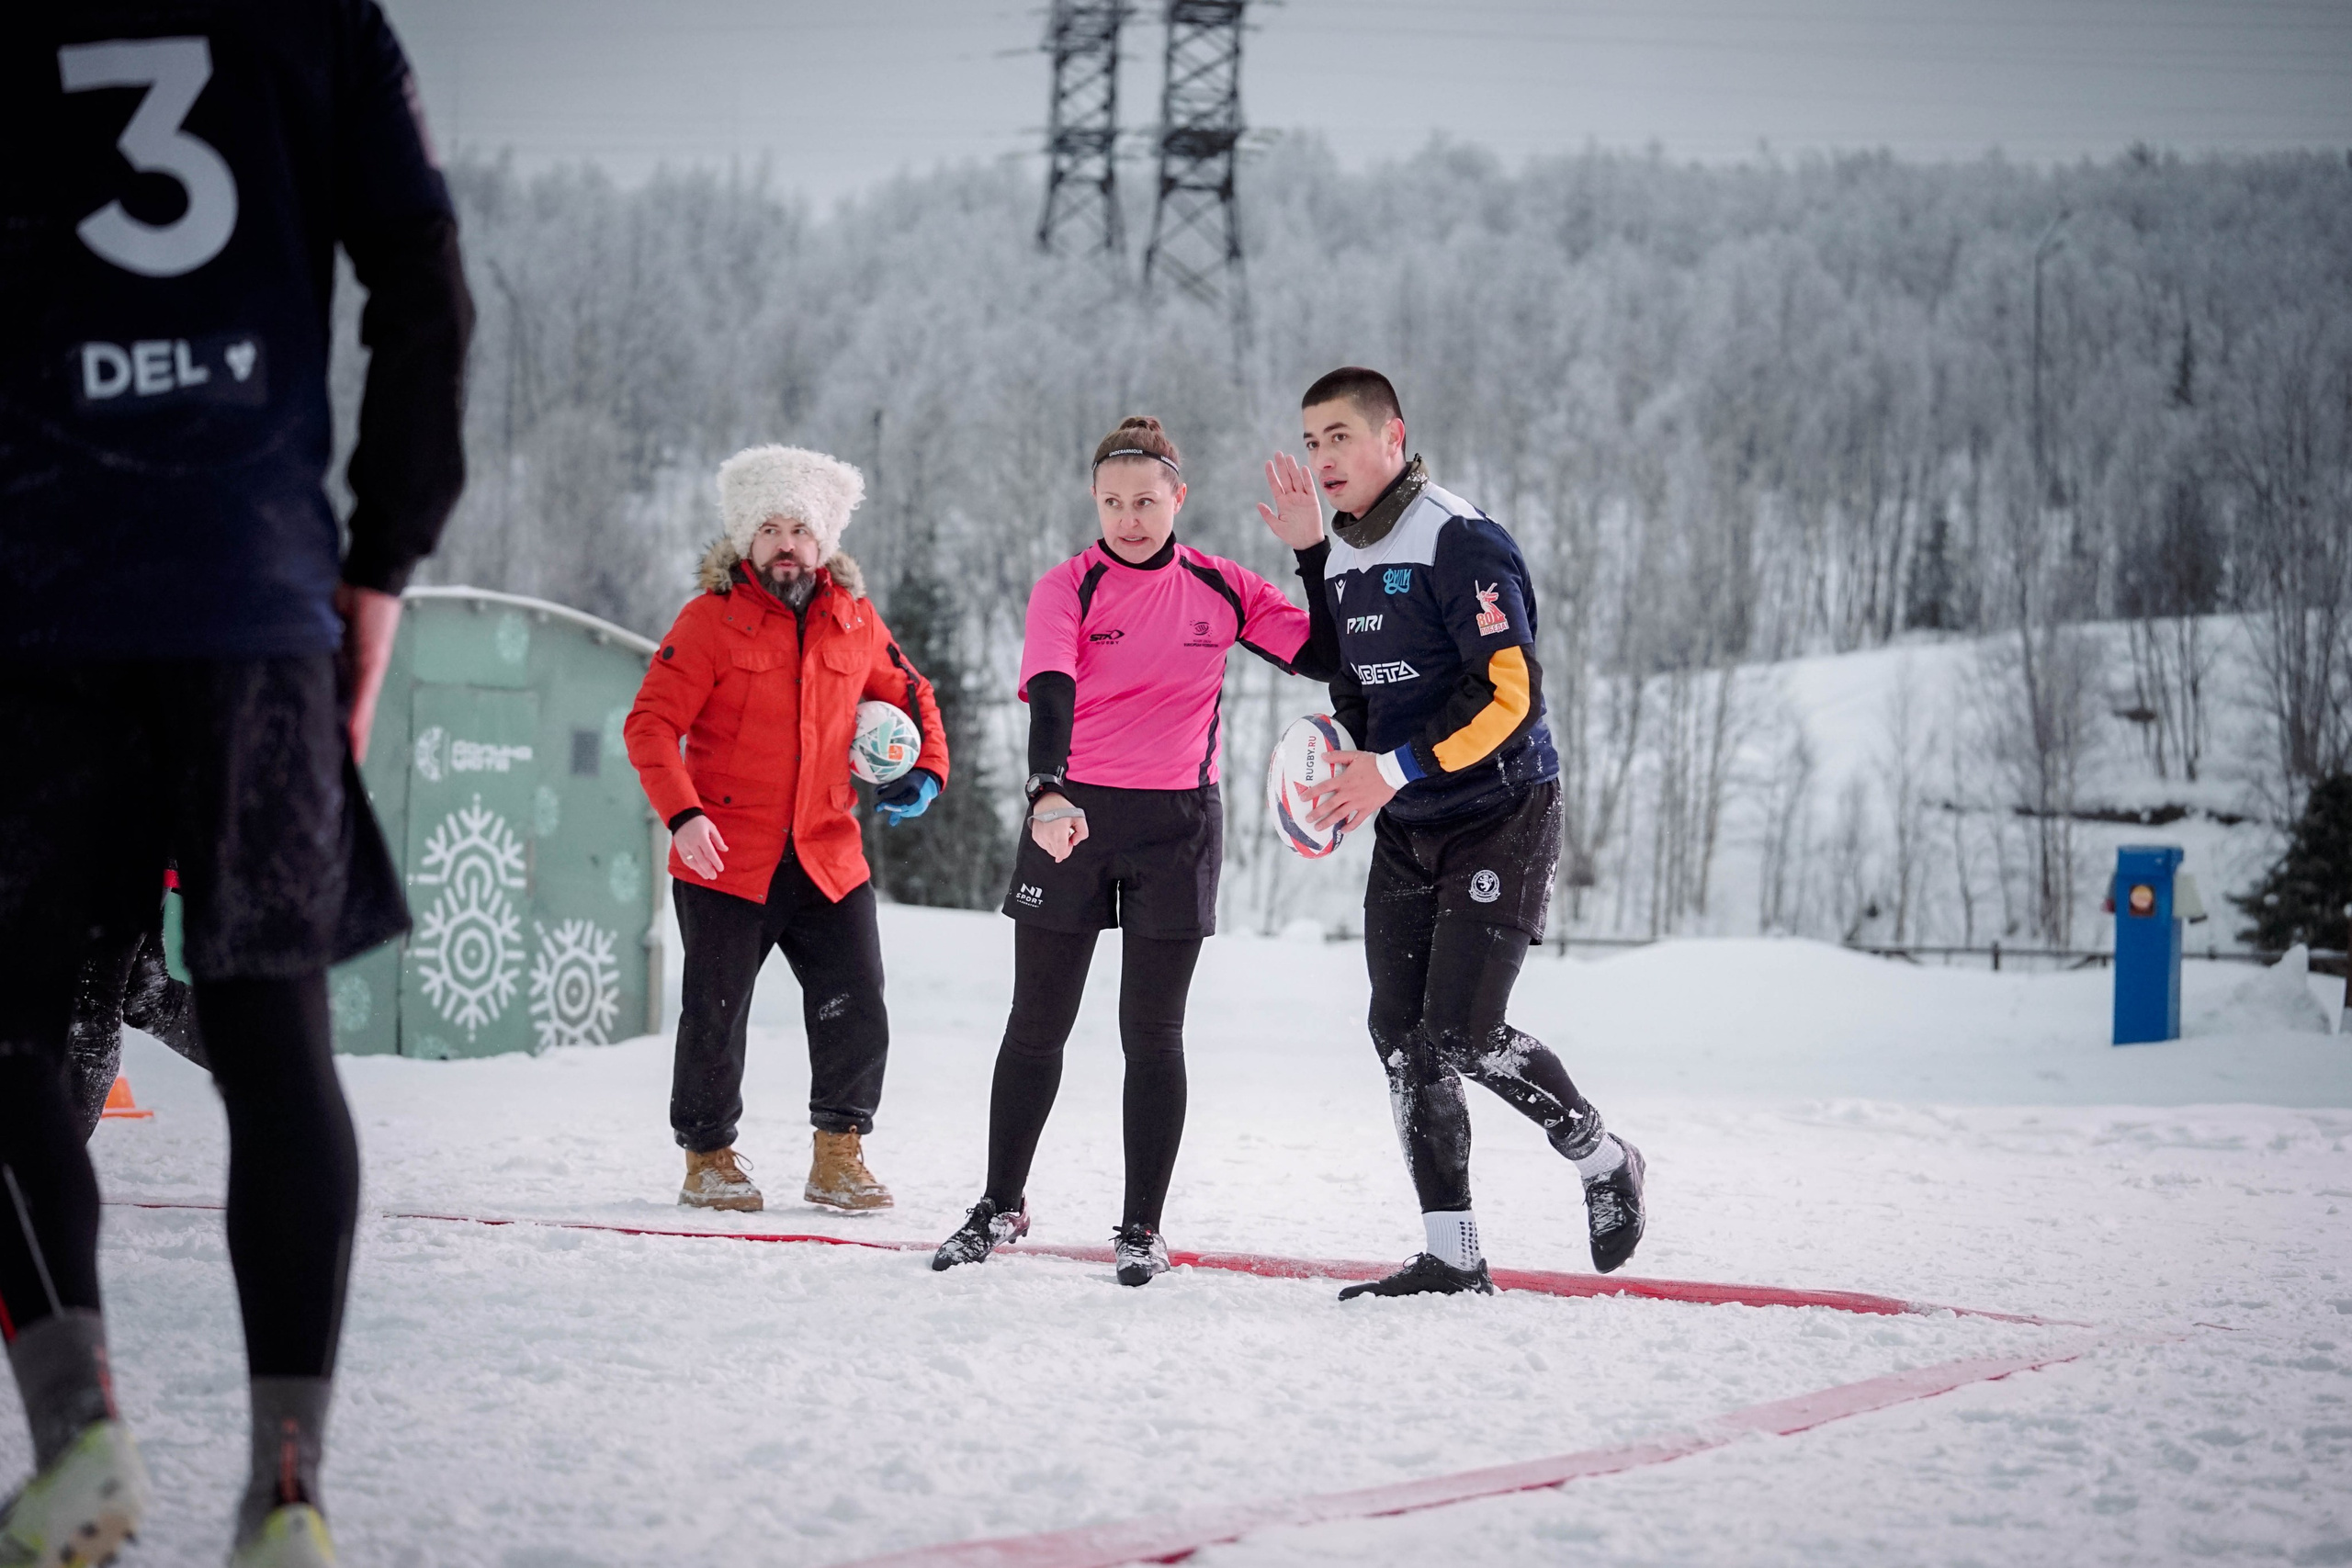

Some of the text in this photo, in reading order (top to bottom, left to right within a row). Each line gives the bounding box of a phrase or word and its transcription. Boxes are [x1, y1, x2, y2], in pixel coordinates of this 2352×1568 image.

[58, 37, 239, 277] 3
[82, 340, 209, 400] DEL
[1306, 736, 1317, 781] RUGBY.RU
[1015, 892, 1044, 906] SPORT
